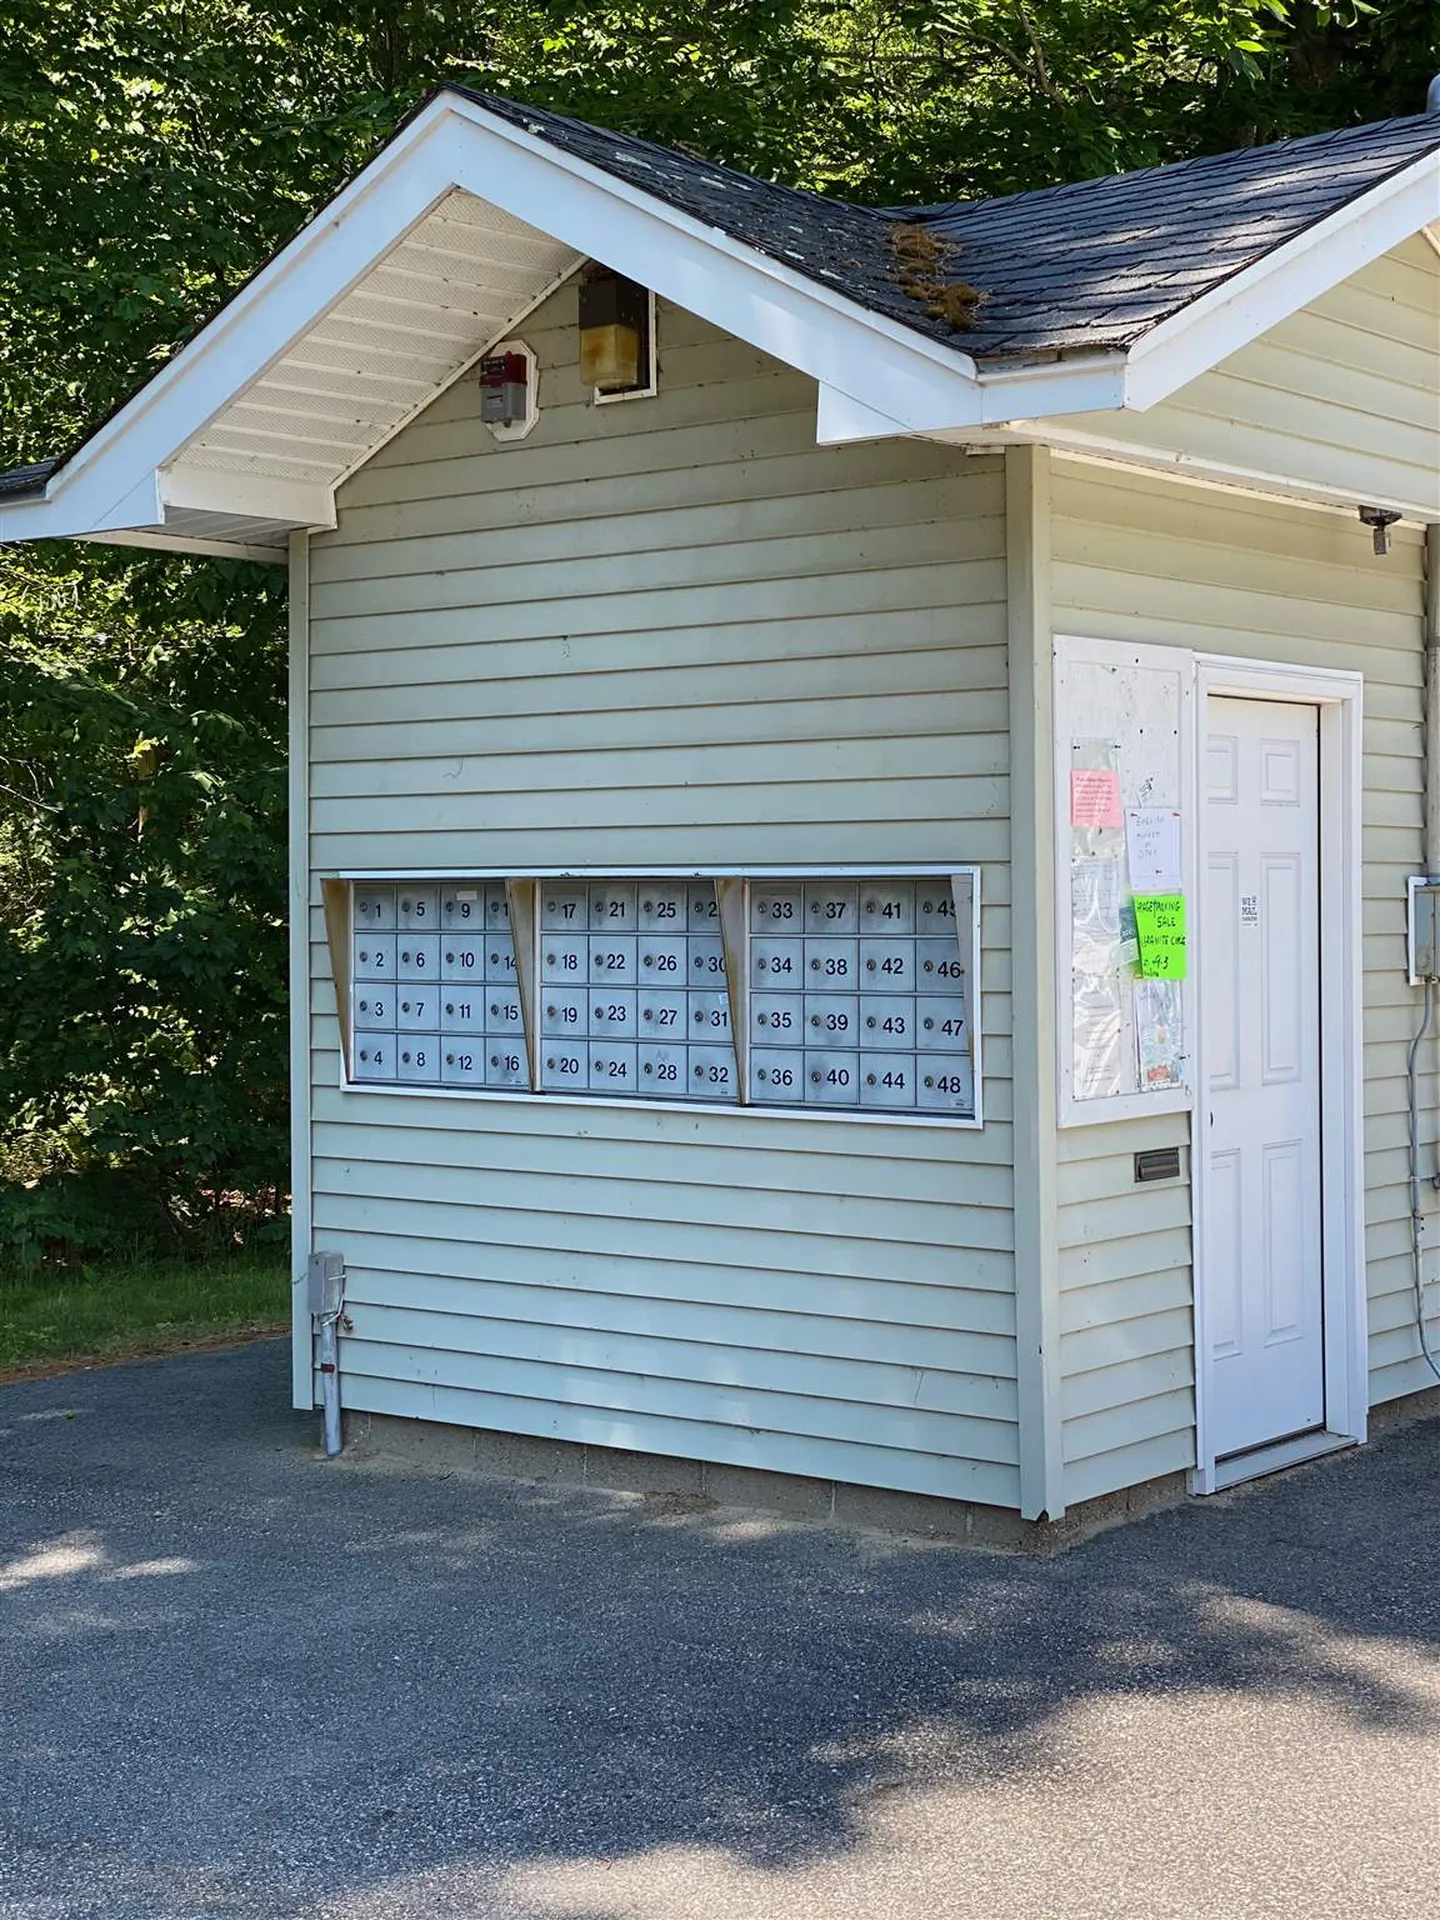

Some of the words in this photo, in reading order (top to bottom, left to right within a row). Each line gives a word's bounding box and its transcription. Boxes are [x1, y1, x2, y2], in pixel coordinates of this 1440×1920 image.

[374, 903, 381, 918] 1
[416, 902, 425, 917] 5
[461, 903, 471, 918] 9
[502, 902, 509, 916] 1
[561, 903, 576, 919] 17
[609, 902, 625, 918] 21
[657, 902, 676, 918] 25
[708, 901, 718, 918] 2
[771, 902, 793, 919] 33
[825, 903, 846, 919] 37
[882, 902, 901, 919] 41
[1157, 915, 1176, 928] SALE
[375, 952, 384, 968] 2
[416, 952, 425, 967] 6
[459, 952, 475, 968] 10
[561, 954, 578, 970] 18
[607, 954, 626, 970] 22
[657, 955, 677, 971] 26
[771, 957, 792, 973] 34
[825, 959, 848, 975] 38
[881, 958, 904, 974] 42
[937, 962, 961, 978] 46
[374, 1002, 384, 1017] 3
[416, 1002, 425, 1017] 7
[459, 1004, 471, 1019] 11
[503, 1005, 518, 1020] 15
[561, 1007, 578, 1023] 19
[607, 1005, 626, 1021] 23
[659, 1009, 678, 1025] 27
[710, 1011, 728, 1027] 31
[770, 1012, 792, 1028] 35
[826, 1014, 848, 1031] 39
[882, 1017, 905, 1034] 43
[941, 1019, 964, 1036] 47
[374, 1050, 383, 1065] 4
[416, 1052, 426, 1066] 8
[458, 1055, 473, 1071] 12
[504, 1055, 520, 1071] 16
[560, 1058, 579, 1074] 20
[608, 1061, 628, 1077] 24
[658, 1064, 677, 1080] 28
[709, 1067, 729, 1083] 32
[771, 1068, 793, 1086] 36
[826, 1069, 849, 1086] 40
[882, 1072, 905, 1089] 44
[937, 1077, 961, 1093] 48
